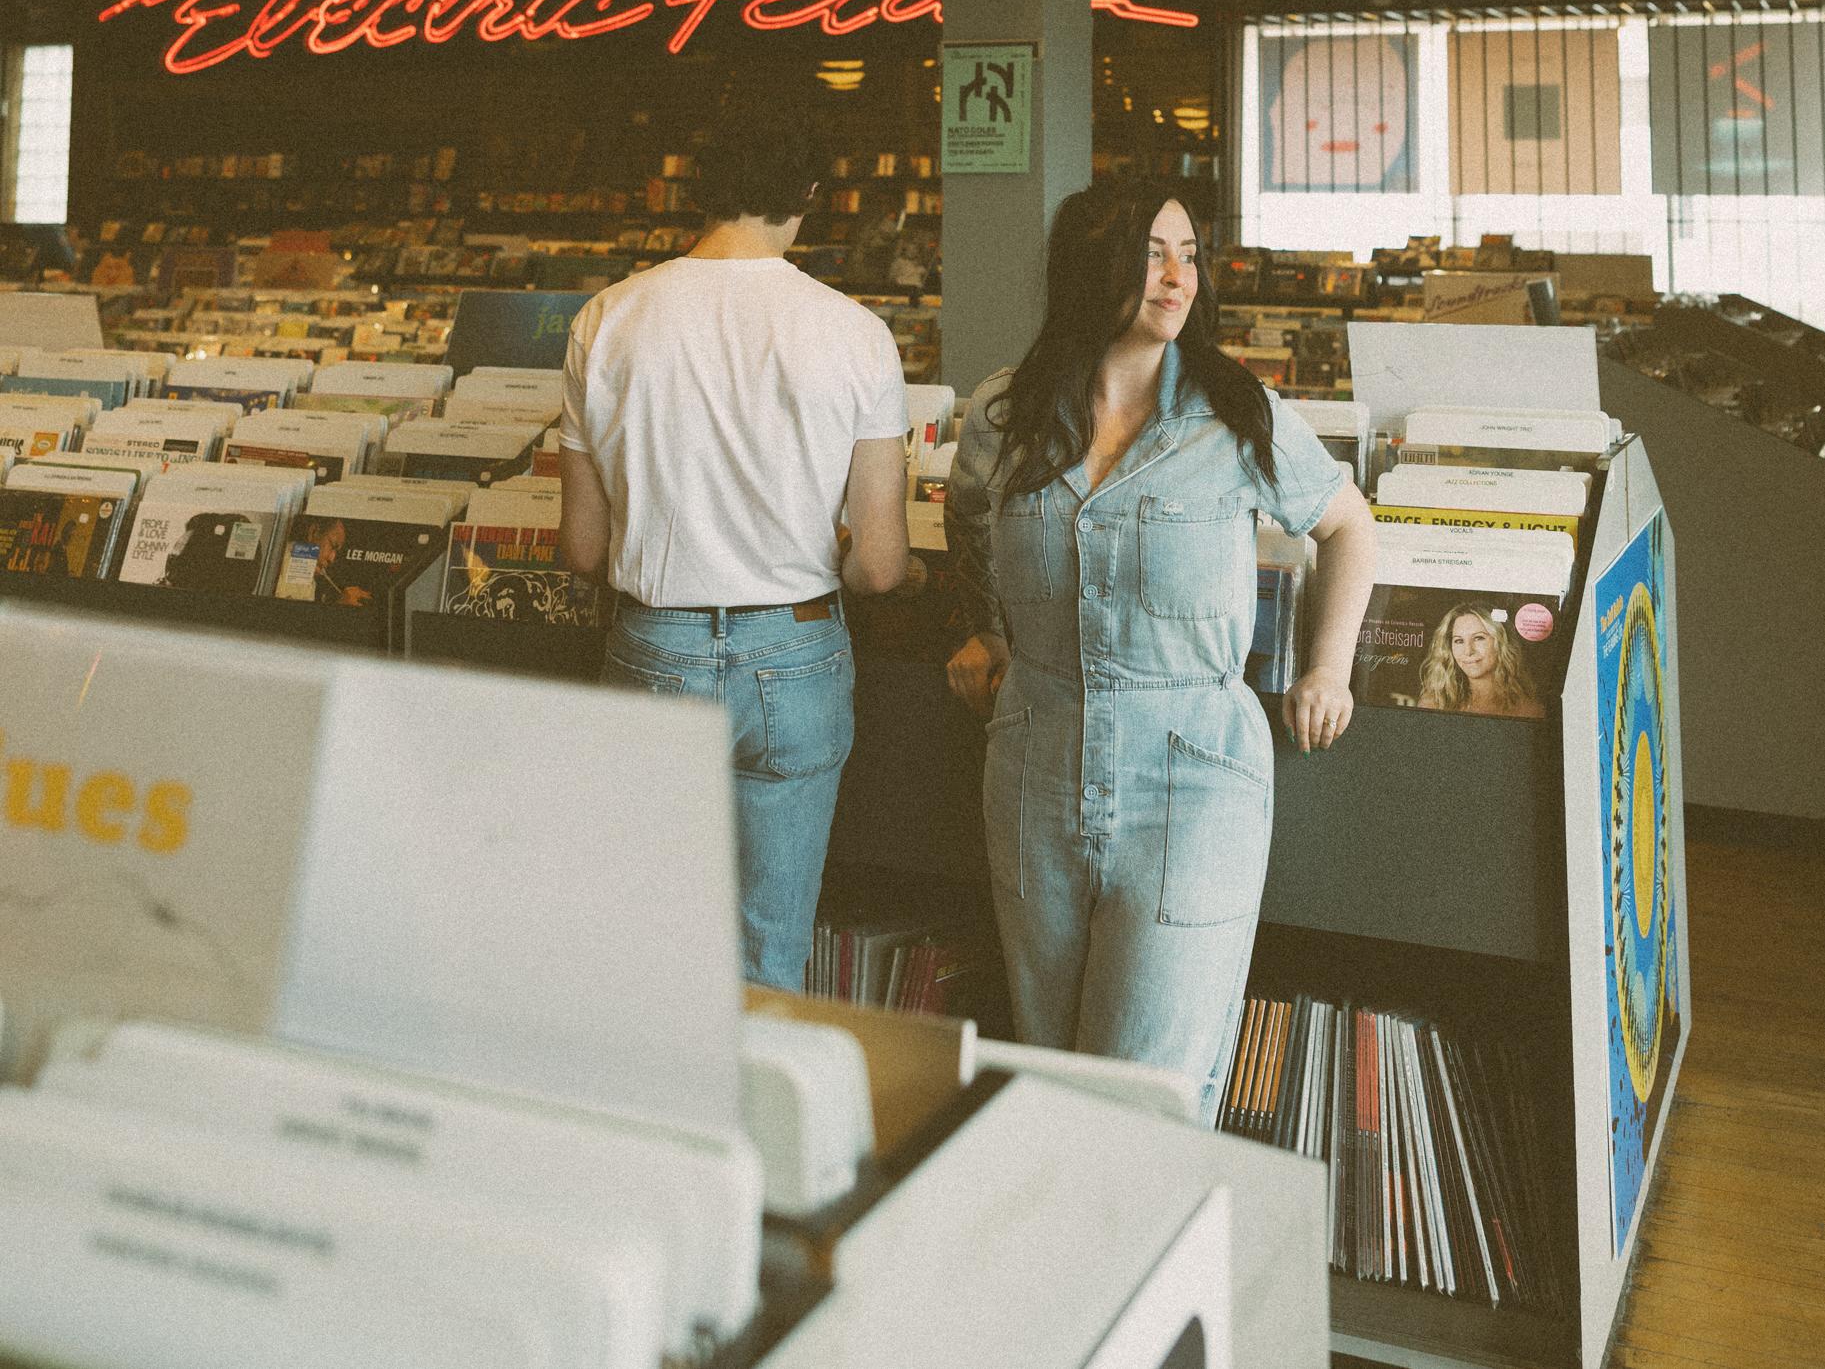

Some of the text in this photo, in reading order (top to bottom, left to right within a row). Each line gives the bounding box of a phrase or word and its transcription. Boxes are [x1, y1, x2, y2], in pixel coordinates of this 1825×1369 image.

[533, 306, 575, 340] ja
[127, 439, 160, 448] STEREO
[1468, 469, 1489, 477] ADRIAN
[141, 518, 171, 530] PEOPLE
[145, 528, 167, 540] LOVE
[134, 541, 169, 551] JOHNNY
[132, 550, 155, 561] LYTLE
[346, 548, 404, 564] LEE MORGAN
[1412, 557, 1473, 566] BARBRA STREISAND
[1374, 627, 1424, 648] Streisand
[1354, 647, 1409, 672] Evergreens
[0, 728, 195, 854] ues
